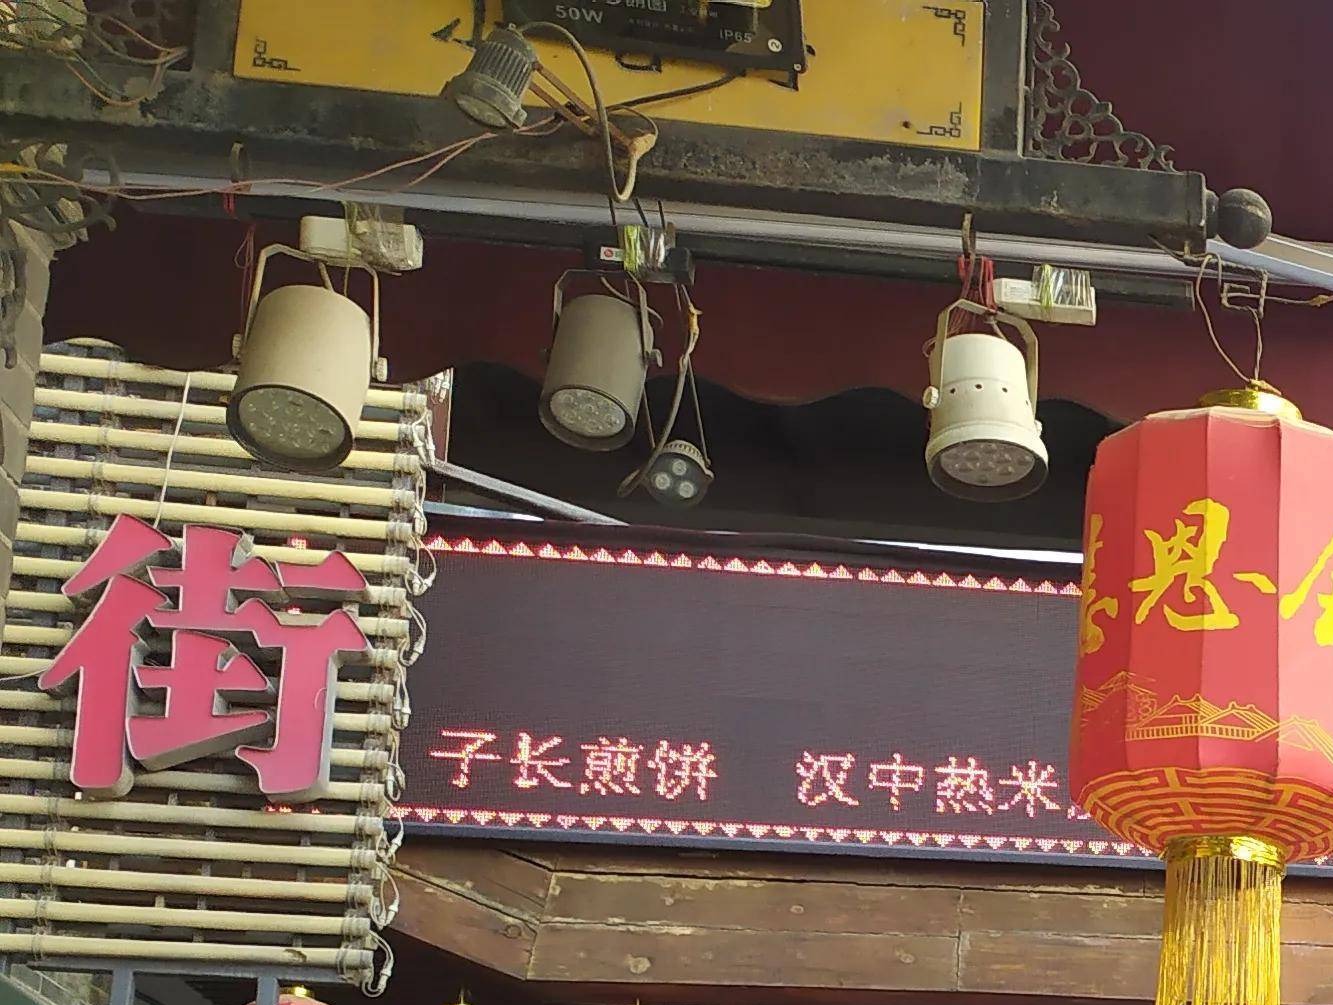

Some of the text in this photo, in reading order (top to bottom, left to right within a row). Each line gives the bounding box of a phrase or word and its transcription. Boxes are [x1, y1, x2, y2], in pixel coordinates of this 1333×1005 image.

[554, 5, 603, 24] 50W
[37, 512, 374, 797] 街
[431, 729, 718, 801] 子长煎饼
[796, 750, 1087, 820] 汉中热米
